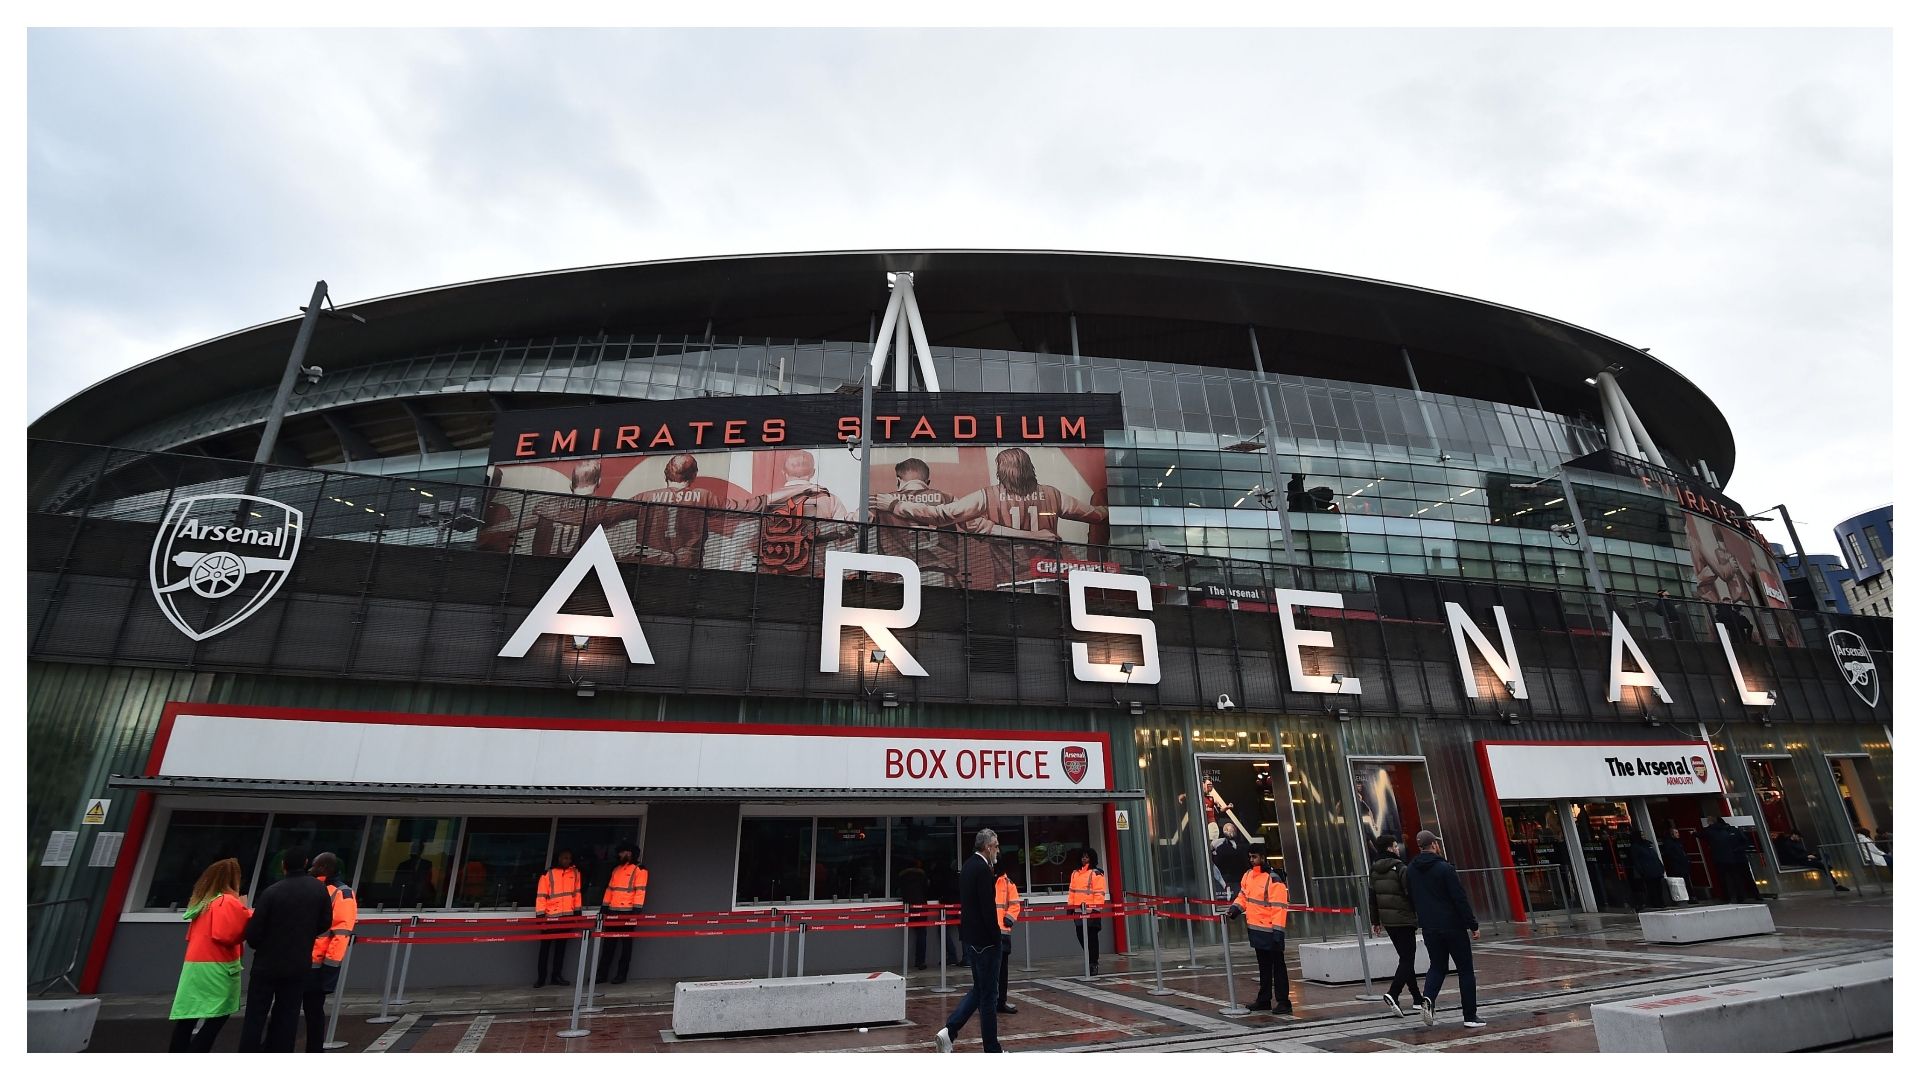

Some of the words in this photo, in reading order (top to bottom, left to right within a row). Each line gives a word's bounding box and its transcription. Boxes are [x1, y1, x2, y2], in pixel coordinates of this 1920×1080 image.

[515, 418, 786, 457] EMIRATES
[836, 415, 1087, 441] STADIUM
[652, 490, 701, 503] WILSON
[1009, 505, 1039, 531] 11
[178, 519, 282, 547] Arsenal
[1208, 585, 1225, 596] The
[497, 524, 1776, 707] ARSENAL
[1836, 645, 1868, 657] Arsenal
[885, 748, 948, 779] BOX
[956, 749, 1050, 780] OFFICE
[1605, 756, 1636, 777] The
[1637, 755, 1691, 776] Arsenal
[1667, 776, 1693, 786] ARMOURY
